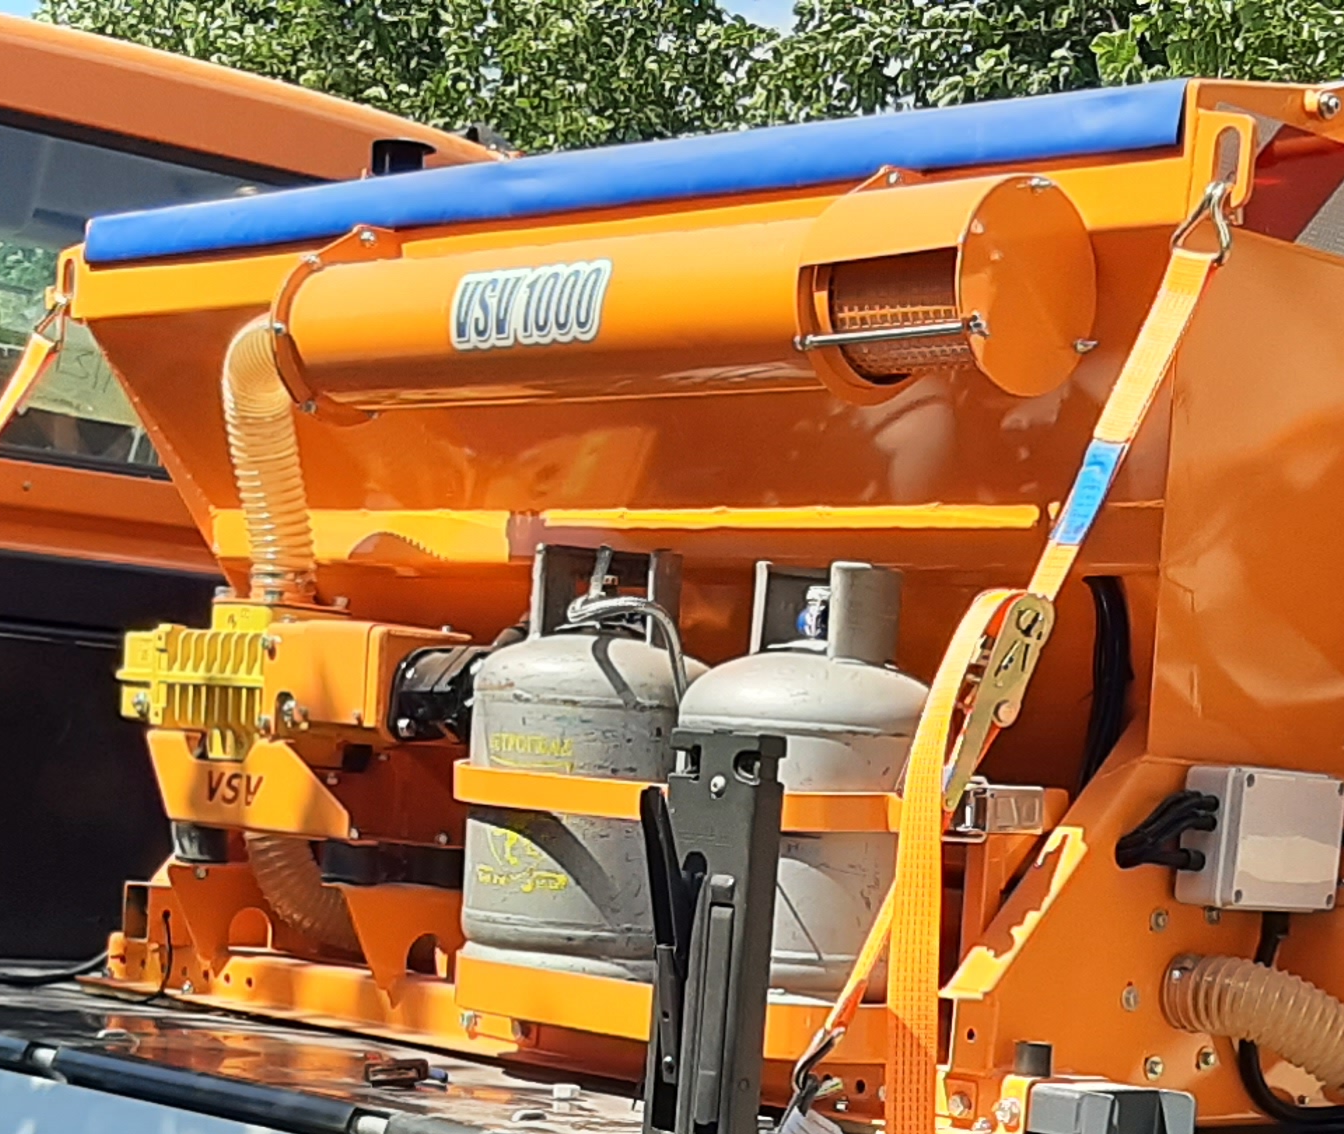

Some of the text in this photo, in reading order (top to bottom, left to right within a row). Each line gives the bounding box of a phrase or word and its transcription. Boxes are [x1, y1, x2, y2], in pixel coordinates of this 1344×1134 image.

[456, 267, 603, 341] VSV 1000
[208, 769, 264, 807] VSV
